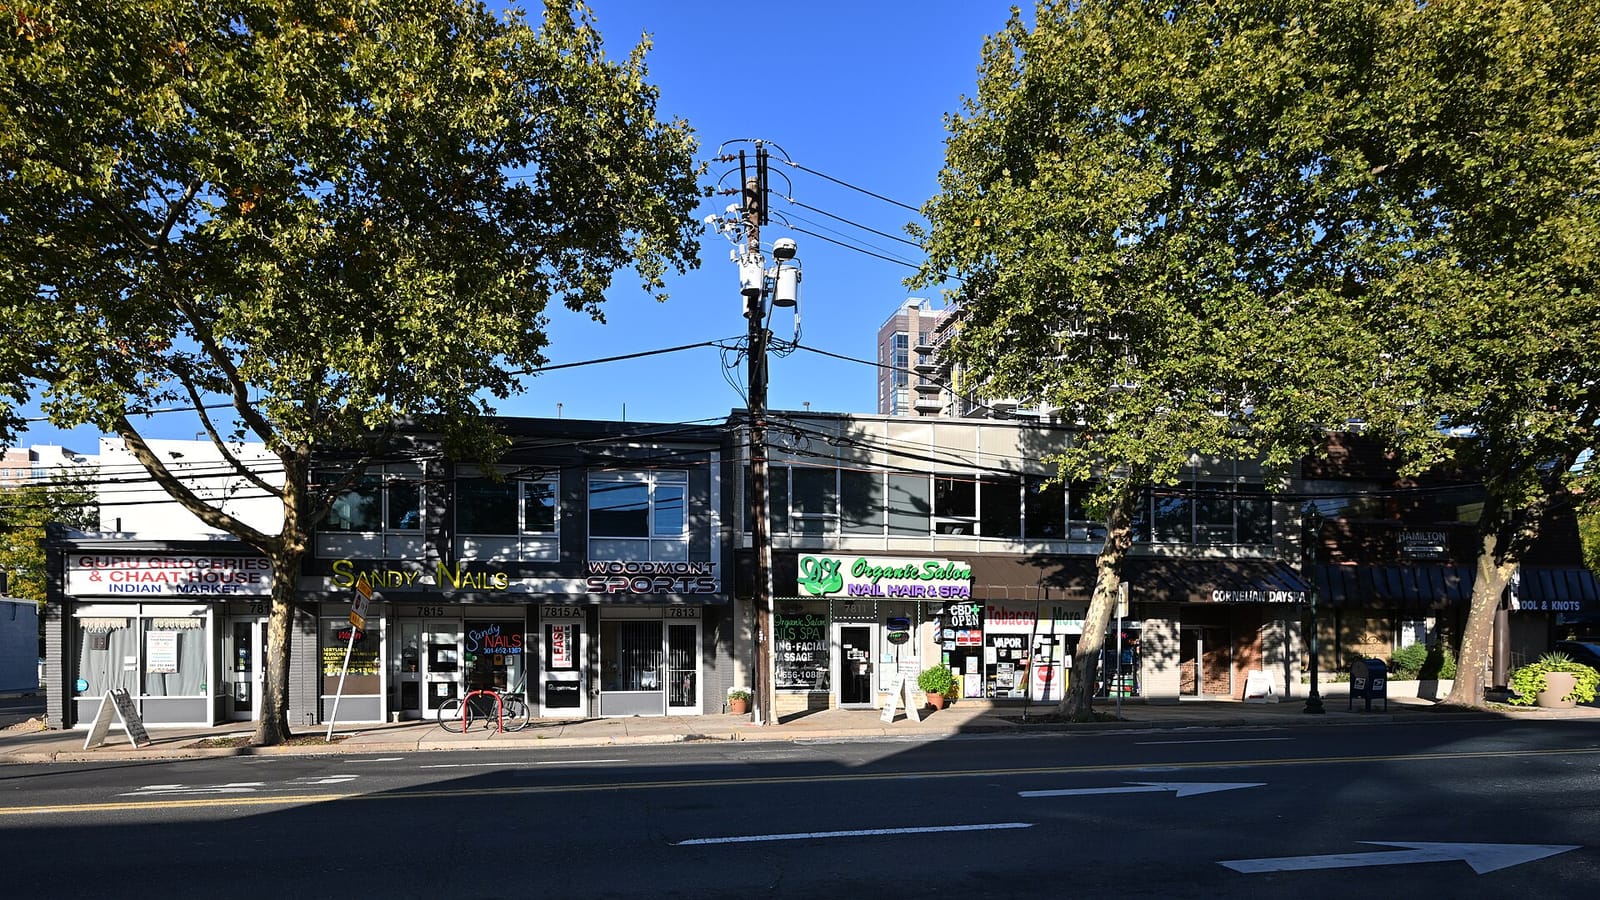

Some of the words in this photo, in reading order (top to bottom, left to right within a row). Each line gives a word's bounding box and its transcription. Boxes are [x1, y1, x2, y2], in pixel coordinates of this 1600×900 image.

[1398, 531, 1446, 543] HAMILTON
[79, 556, 140, 568] GURU
[147, 557, 271, 570] GROCERIES
[588, 562, 717, 575] WOODMONT
[331, 559, 419, 589] SANDY
[436, 561, 509, 590] NAILS
[851, 557, 920, 583] Organic
[918, 560, 972, 581] Salon
[89, 571, 102, 582] &
[109, 571, 182, 582] CHAAT
[188, 572, 260, 584] HOUSE
[109, 583, 162, 593] INDIAN
[176, 584, 240, 593] MARKET
[586, 576, 717, 593] SPORTS
[848, 583, 885, 597] NAIL
[888, 584, 926, 598] HAIR
[927, 585, 938, 597] &
[939, 585, 971, 598] SPA
[1212, 590, 1265, 602] CORNELIAN
[417, 606, 444, 616] 7815
[544, 607, 570, 617] 7815
[572, 607, 581, 617] A
[845, 604, 866, 613] 7811
[1521, 600, 1539, 610] OOL
[1541, 600, 1548, 610] &
[1551, 600, 1581, 611] KNOTS
[670, 608, 695, 617] 7813
[987, 606, 1036, 625] Tobacco
[1053, 607, 1080, 625] More
[951, 615, 979, 627] OPEN
[466, 623, 500, 652] Sandy
[774, 627, 796, 640] AILS
[799, 627, 821, 640] SPA
[483, 633, 521, 648] NAILS
[553, 625, 564, 661] LEASE
[993, 637, 1022, 649] VAPOR
